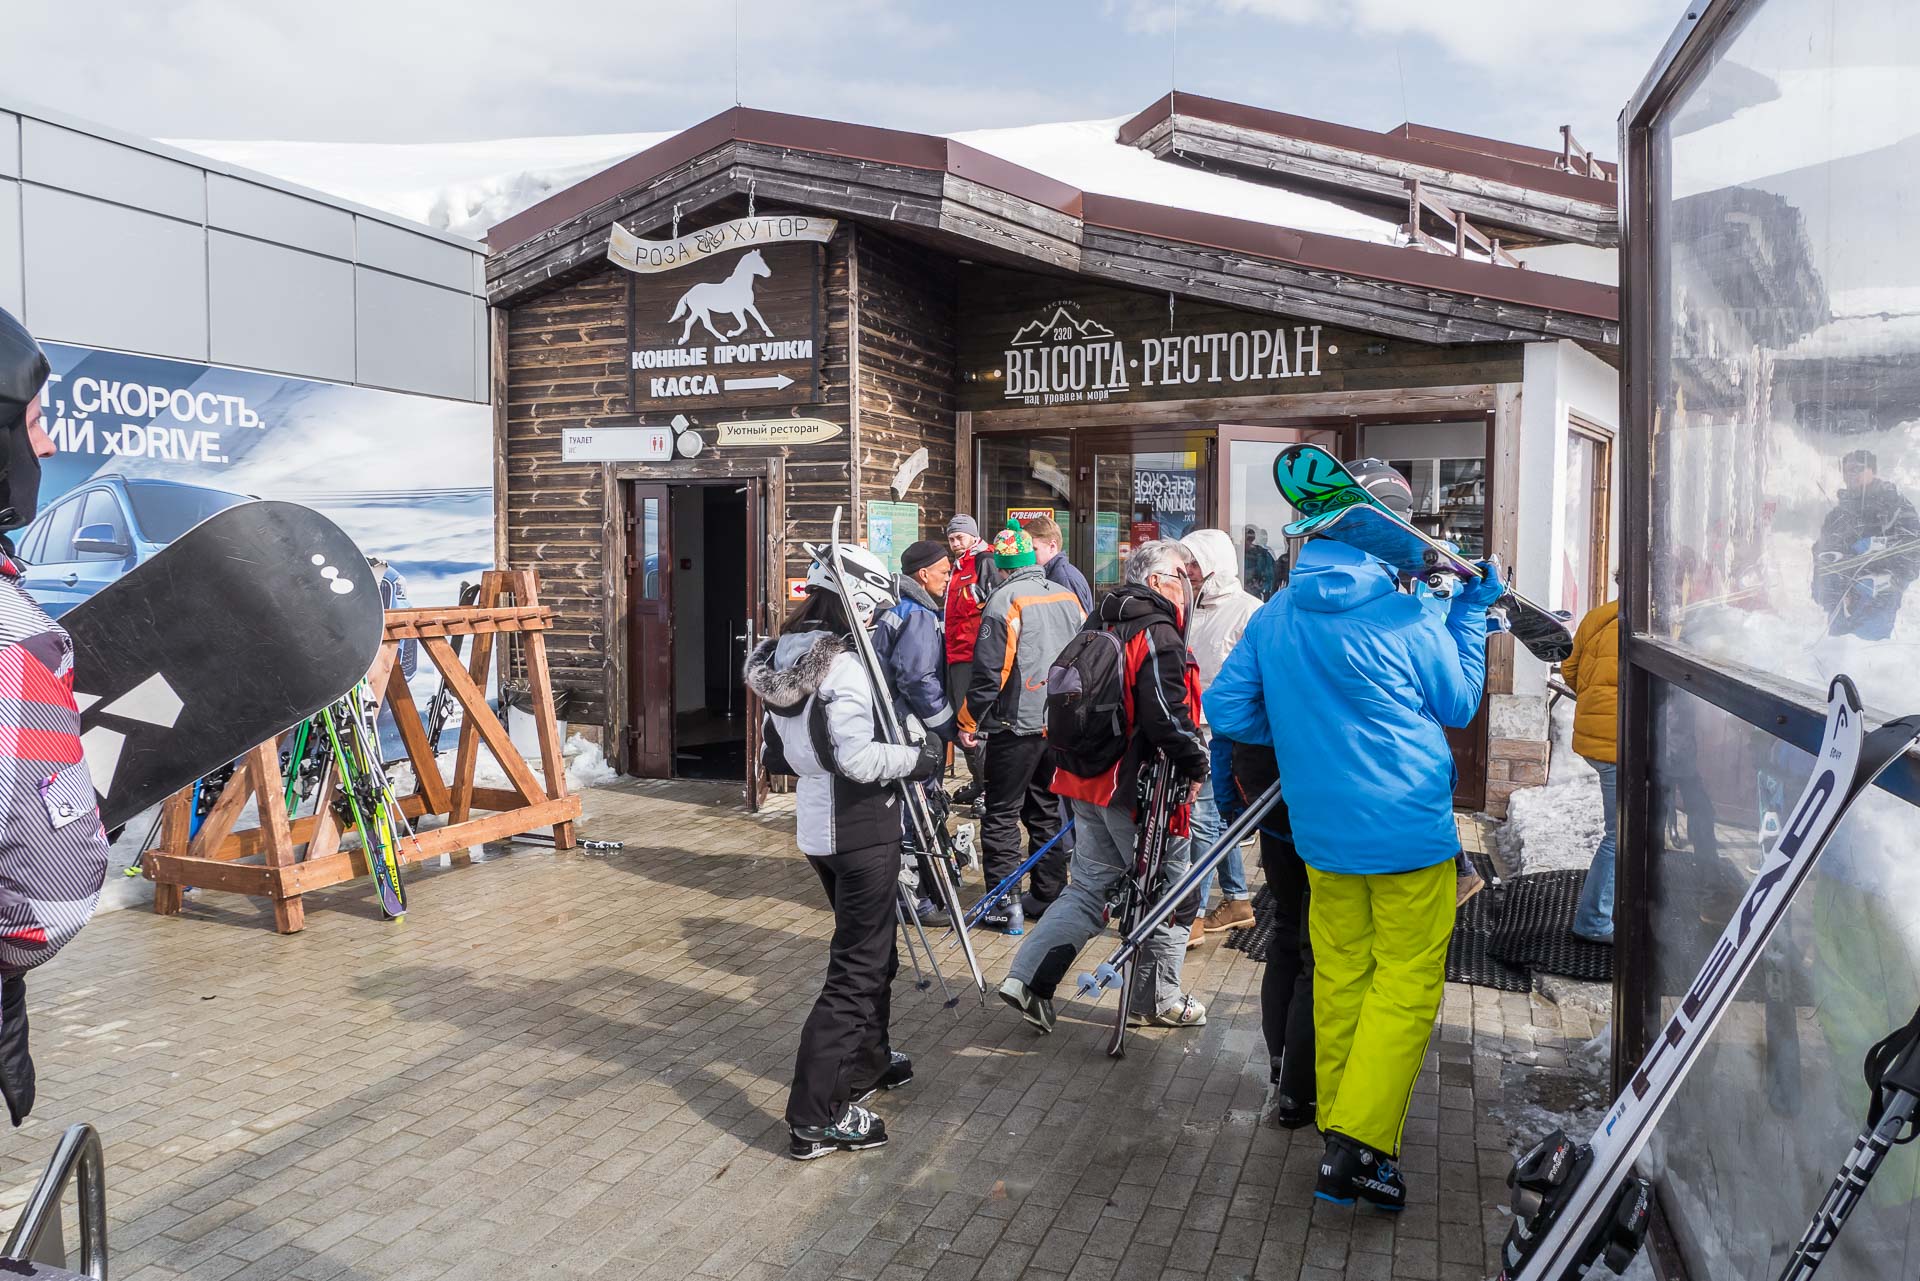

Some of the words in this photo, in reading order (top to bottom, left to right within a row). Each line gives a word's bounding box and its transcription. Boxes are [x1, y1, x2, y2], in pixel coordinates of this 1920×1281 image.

[635, 243, 690, 267] РОЗА
[729, 217, 810, 242] ХУТОР
[1053, 326, 1073, 341] 2320
[631, 346, 708, 370] КОННЫЕ
[713, 339, 813, 364] ПРОГУЛКИ
[1004, 341, 1130, 395] ВЫСОТА
[1141, 325, 1323, 387] РЕСТОРАН
[650, 374, 719, 398] КАССА
[1024, 393, 1040, 405] над
[1044, 391, 1083, 405] уровнем
[1087, 389, 1110, 402] моря
[72, 376, 266, 430] СКОРОСТЬ.
[101, 423, 229, 464] xDRIVE.
[568, 436, 593, 445] ТУАЛЕТ
[727, 423, 767, 436] Уютный
[770, 425, 819, 437] ресторан
[1632, 769, 1835, 1102] HEAD
